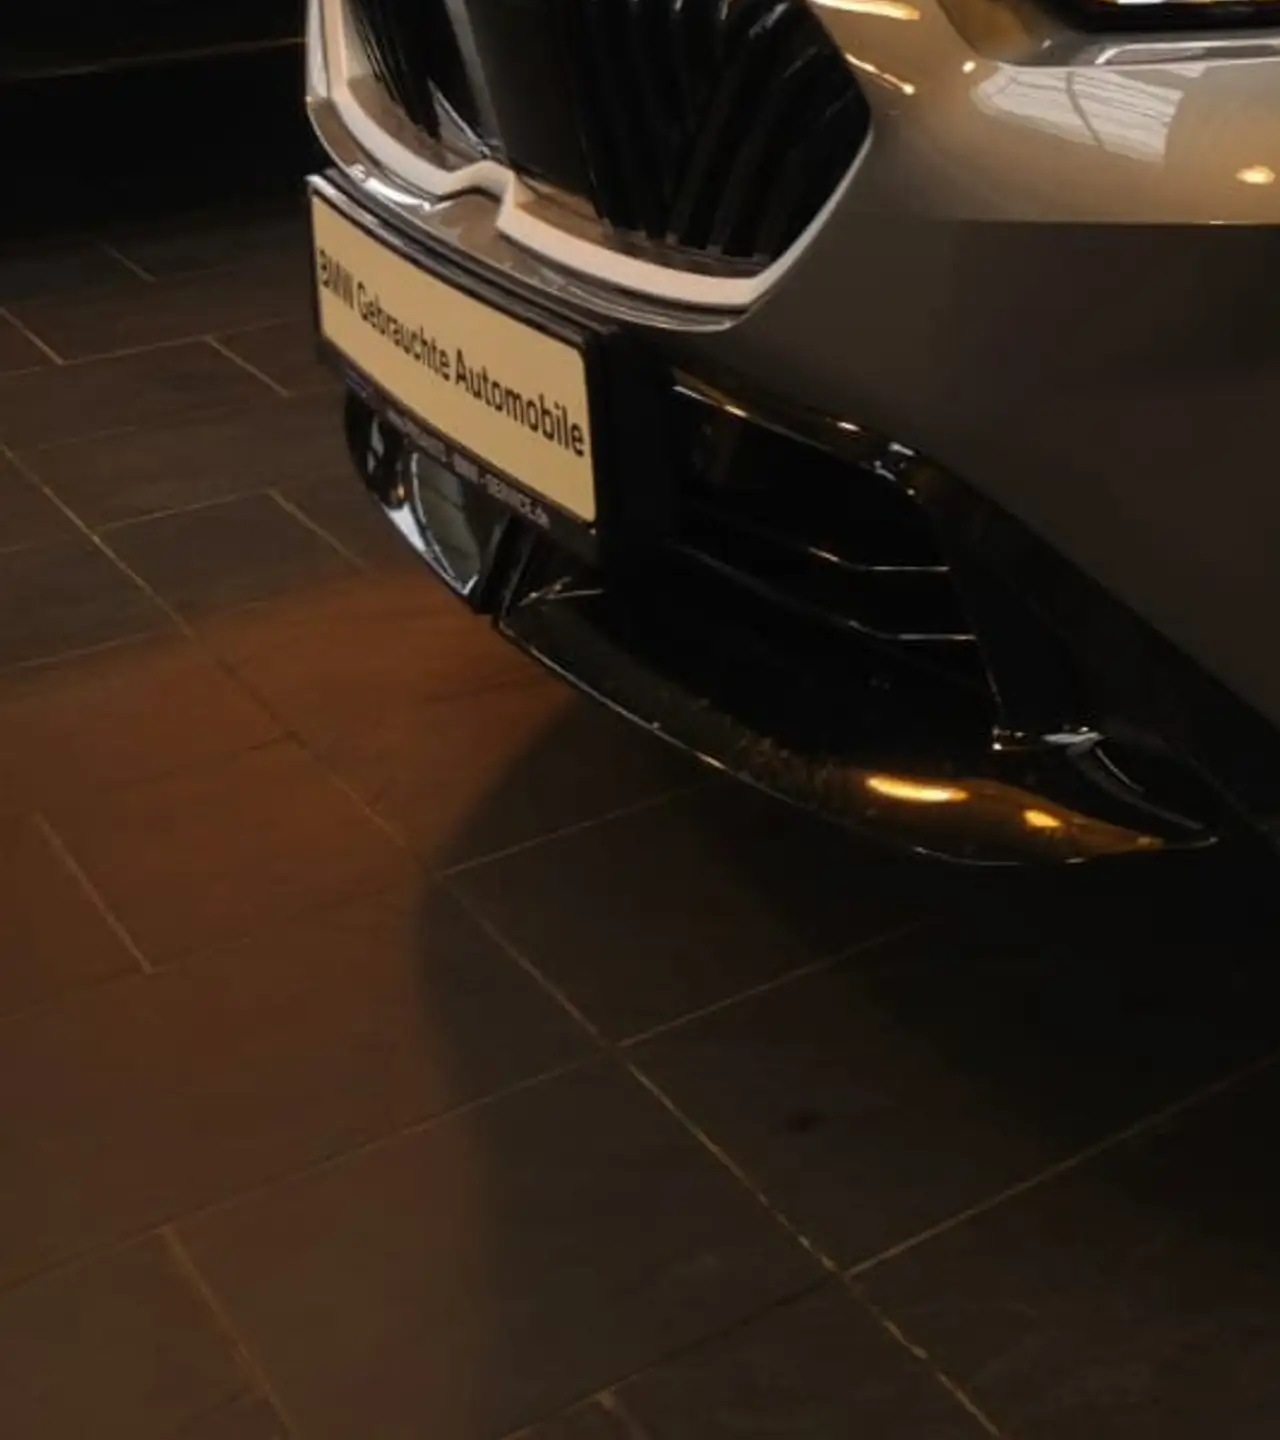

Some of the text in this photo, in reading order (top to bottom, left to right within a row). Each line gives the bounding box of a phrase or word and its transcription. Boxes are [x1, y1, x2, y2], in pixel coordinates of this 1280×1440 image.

[318, 248, 354, 311] BMW
[356, 280, 452, 382] Gebrauchte
[454, 348, 586, 458] Automobile
